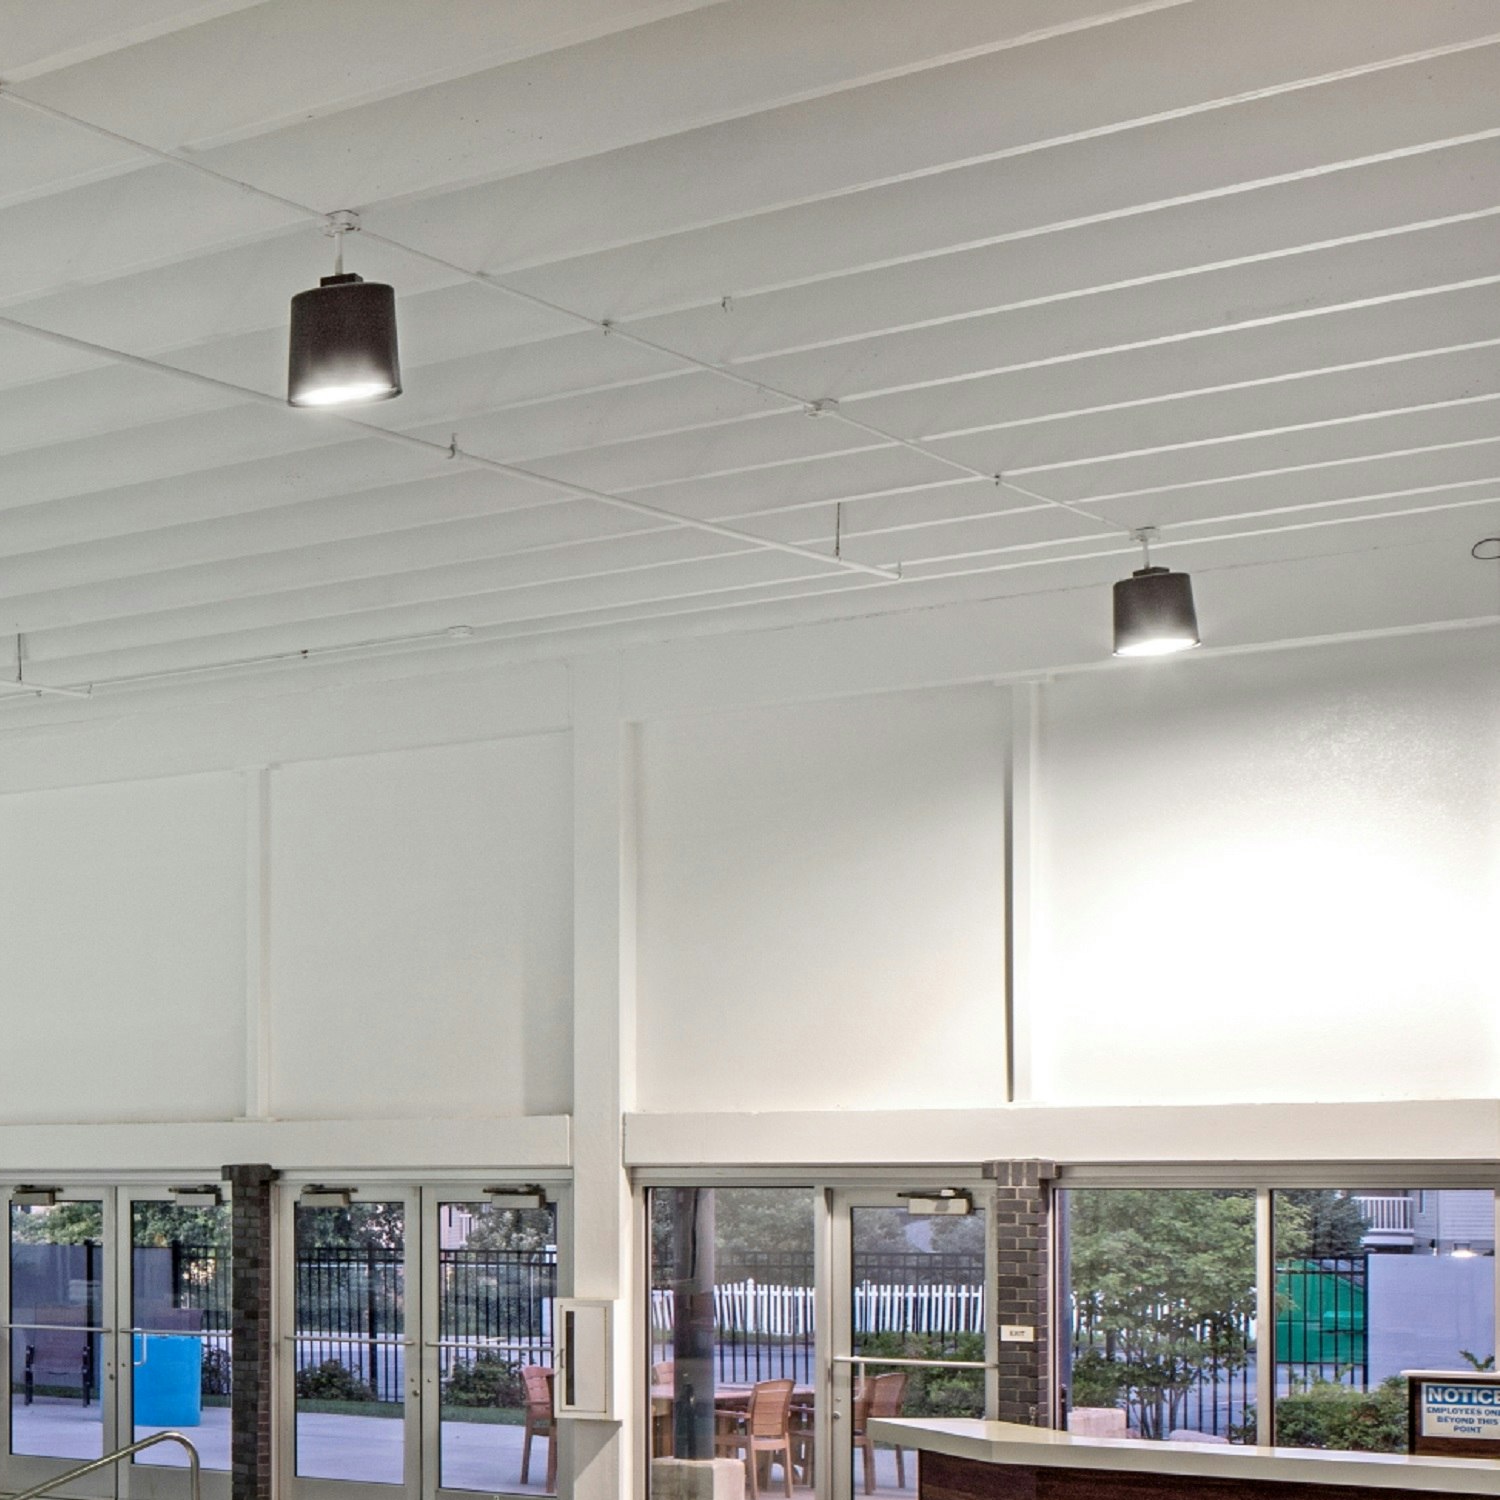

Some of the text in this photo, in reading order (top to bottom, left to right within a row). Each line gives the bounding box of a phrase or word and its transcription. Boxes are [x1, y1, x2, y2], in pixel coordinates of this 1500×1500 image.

[1428, 1387, 1500, 1405] NOTICE
[1426, 1406, 1482, 1415] EMPLOYEES
[1437, 1415, 1499, 1426] BEYOND THIS
[1453, 1425, 1482, 1434] POINT
